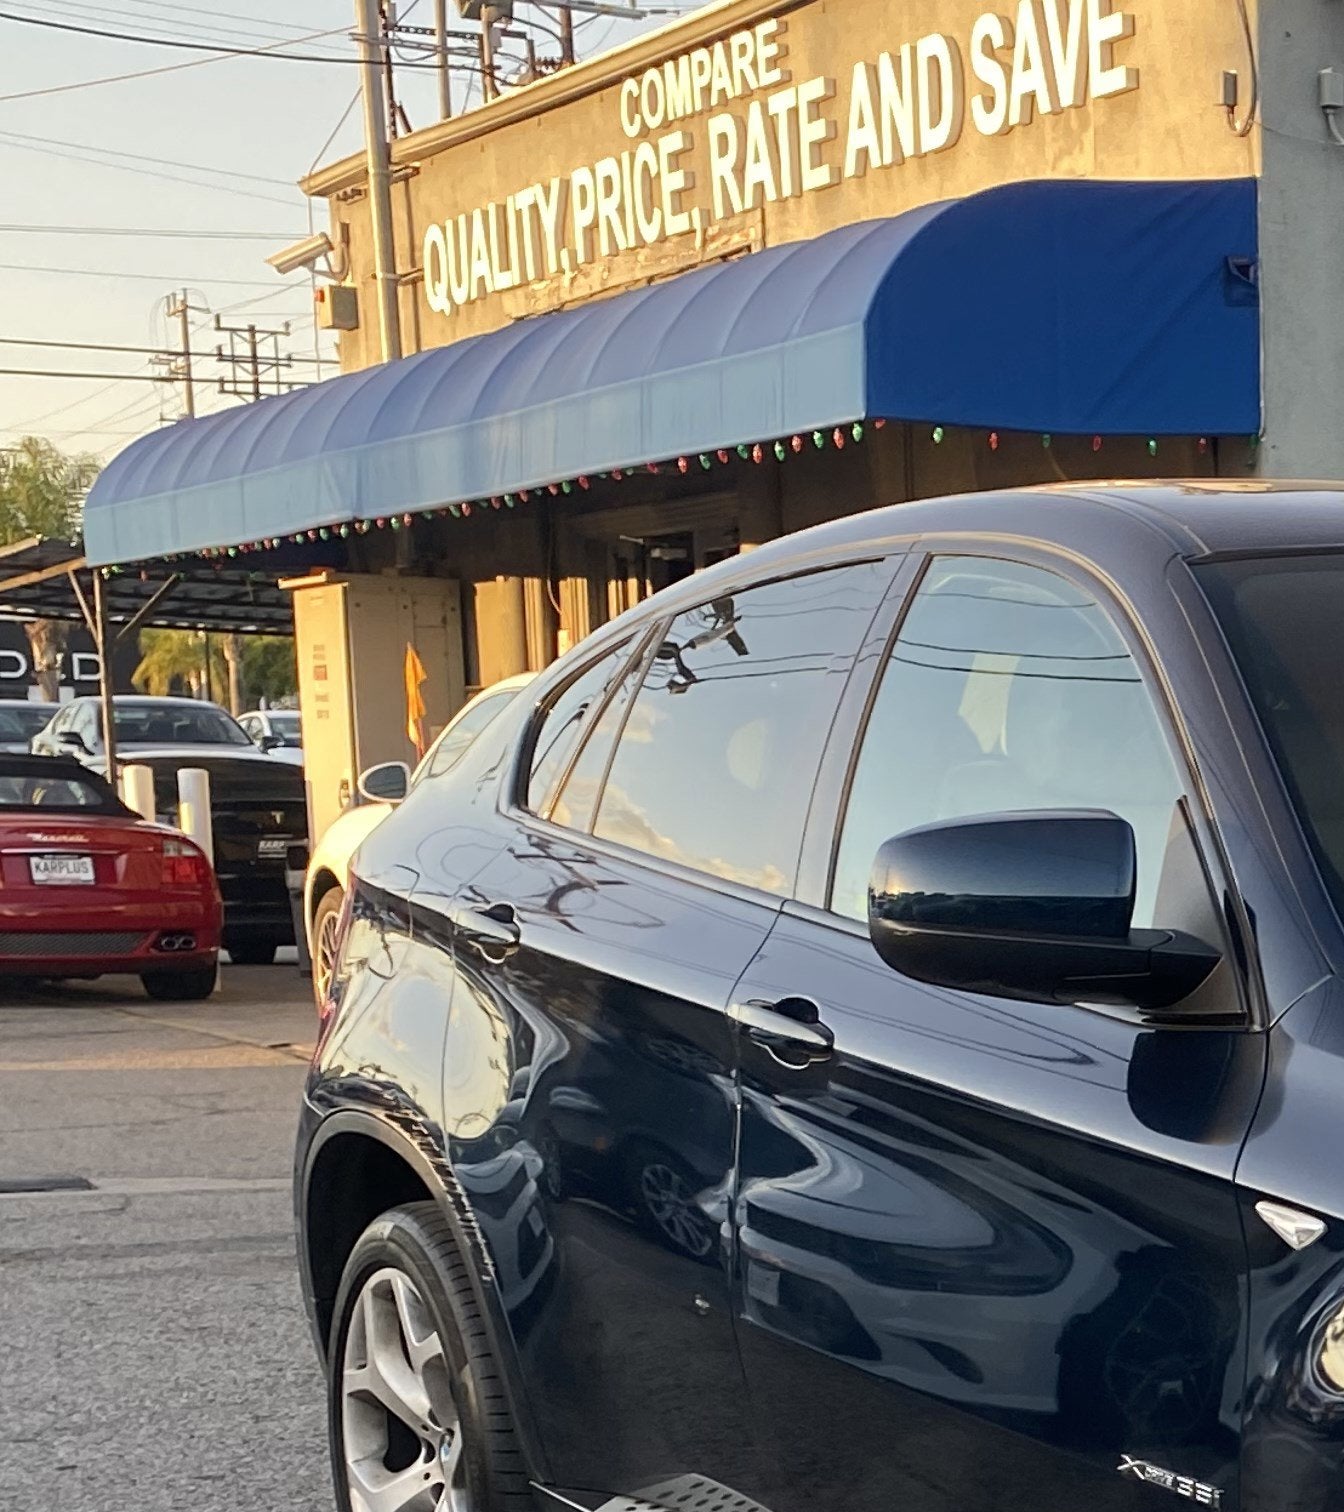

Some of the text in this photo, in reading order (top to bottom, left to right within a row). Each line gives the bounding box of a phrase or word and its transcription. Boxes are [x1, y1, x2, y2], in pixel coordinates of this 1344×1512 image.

[620, 17, 789, 139] COMPARE
[709, 76, 840, 219] RATE
[845, 32, 962, 178] AND
[971, 0, 1138, 136] SAVE
[34, 861, 89, 874] KARPLUS
